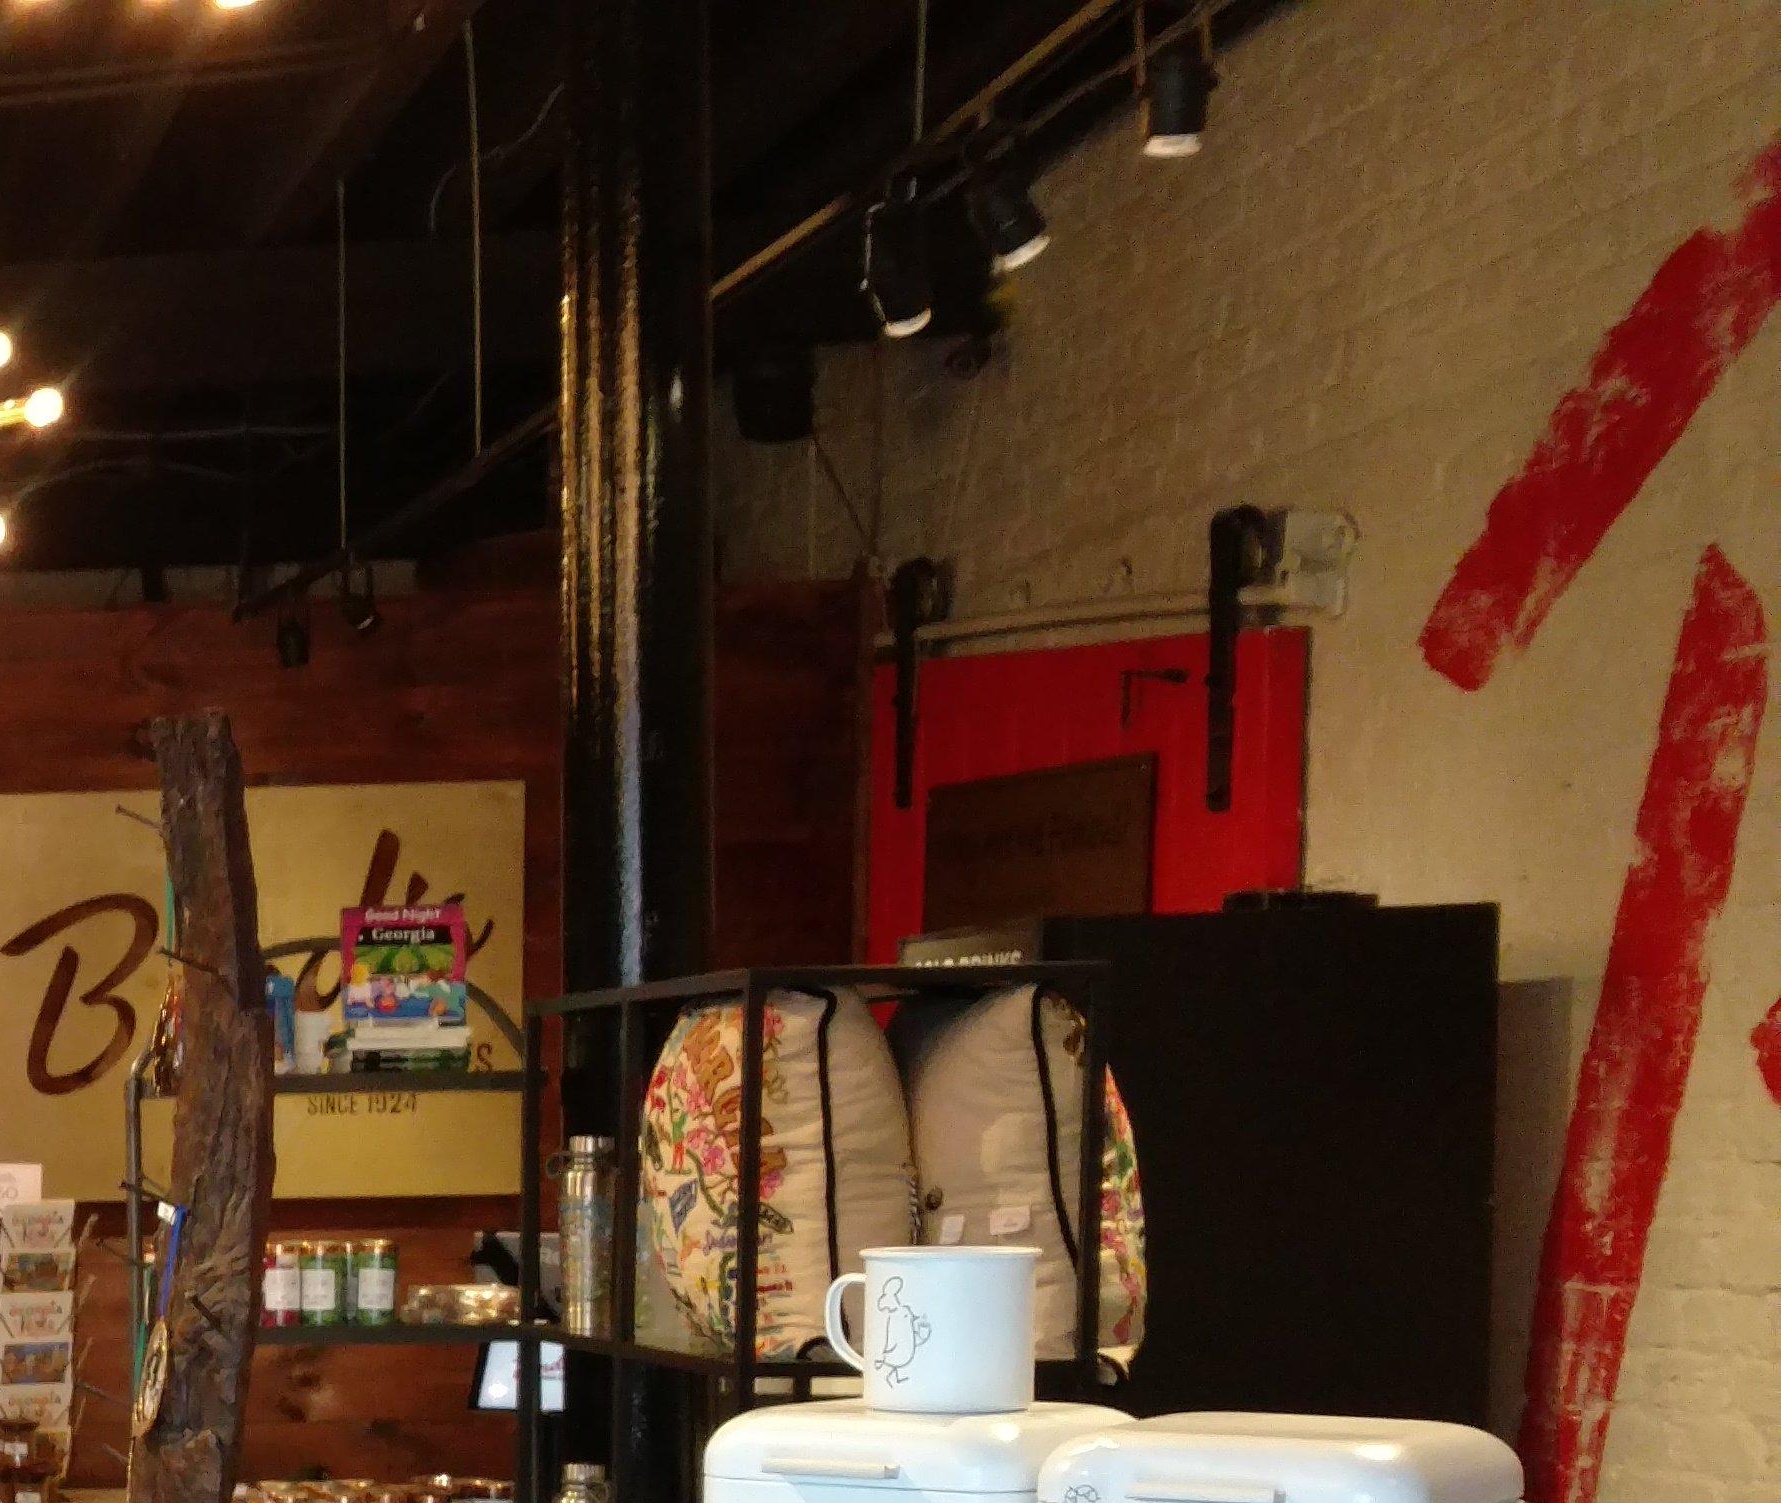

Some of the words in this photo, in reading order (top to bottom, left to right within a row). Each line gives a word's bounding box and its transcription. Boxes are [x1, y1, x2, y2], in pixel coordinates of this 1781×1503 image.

[371, 927, 436, 944] Georgia
[307, 1094, 358, 1115] SINCE
[367, 1093, 418, 1113] 1924
